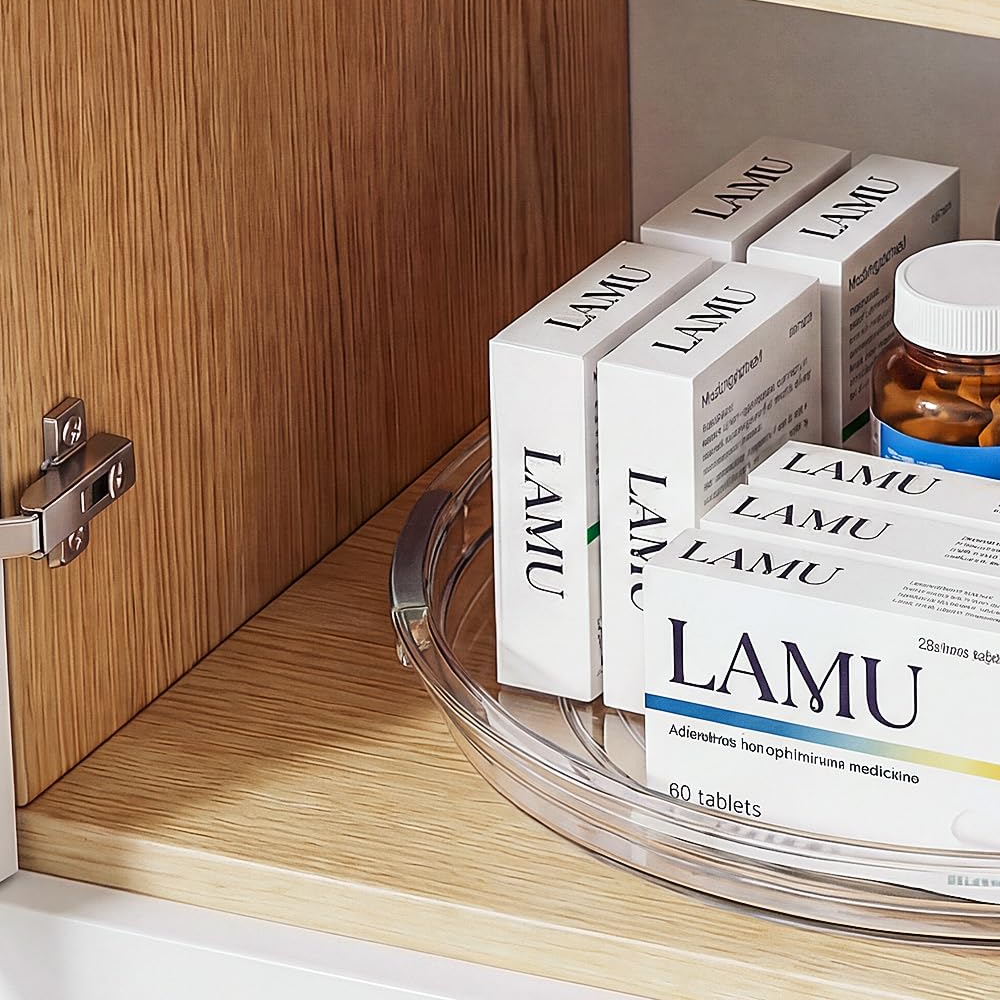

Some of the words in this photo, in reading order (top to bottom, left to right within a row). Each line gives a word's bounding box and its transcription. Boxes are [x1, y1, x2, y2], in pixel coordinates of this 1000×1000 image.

[692, 156, 793, 220] LAMU
[799, 176, 899, 239] LAMU
[544, 264, 652, 331] LAMU
[652, 286, 757, 354] LAMU
[780, 452, 941, 497] LAMU
[523, 446, 564, 599] LAMU
[730, 496, 892, 541] LAMU
[678, 540, 844, 586] LAMU
[667, 617, 923, 729] LAMU
[669, 782, 691, 801] 60
[698, 790, 762, 818] tablets
